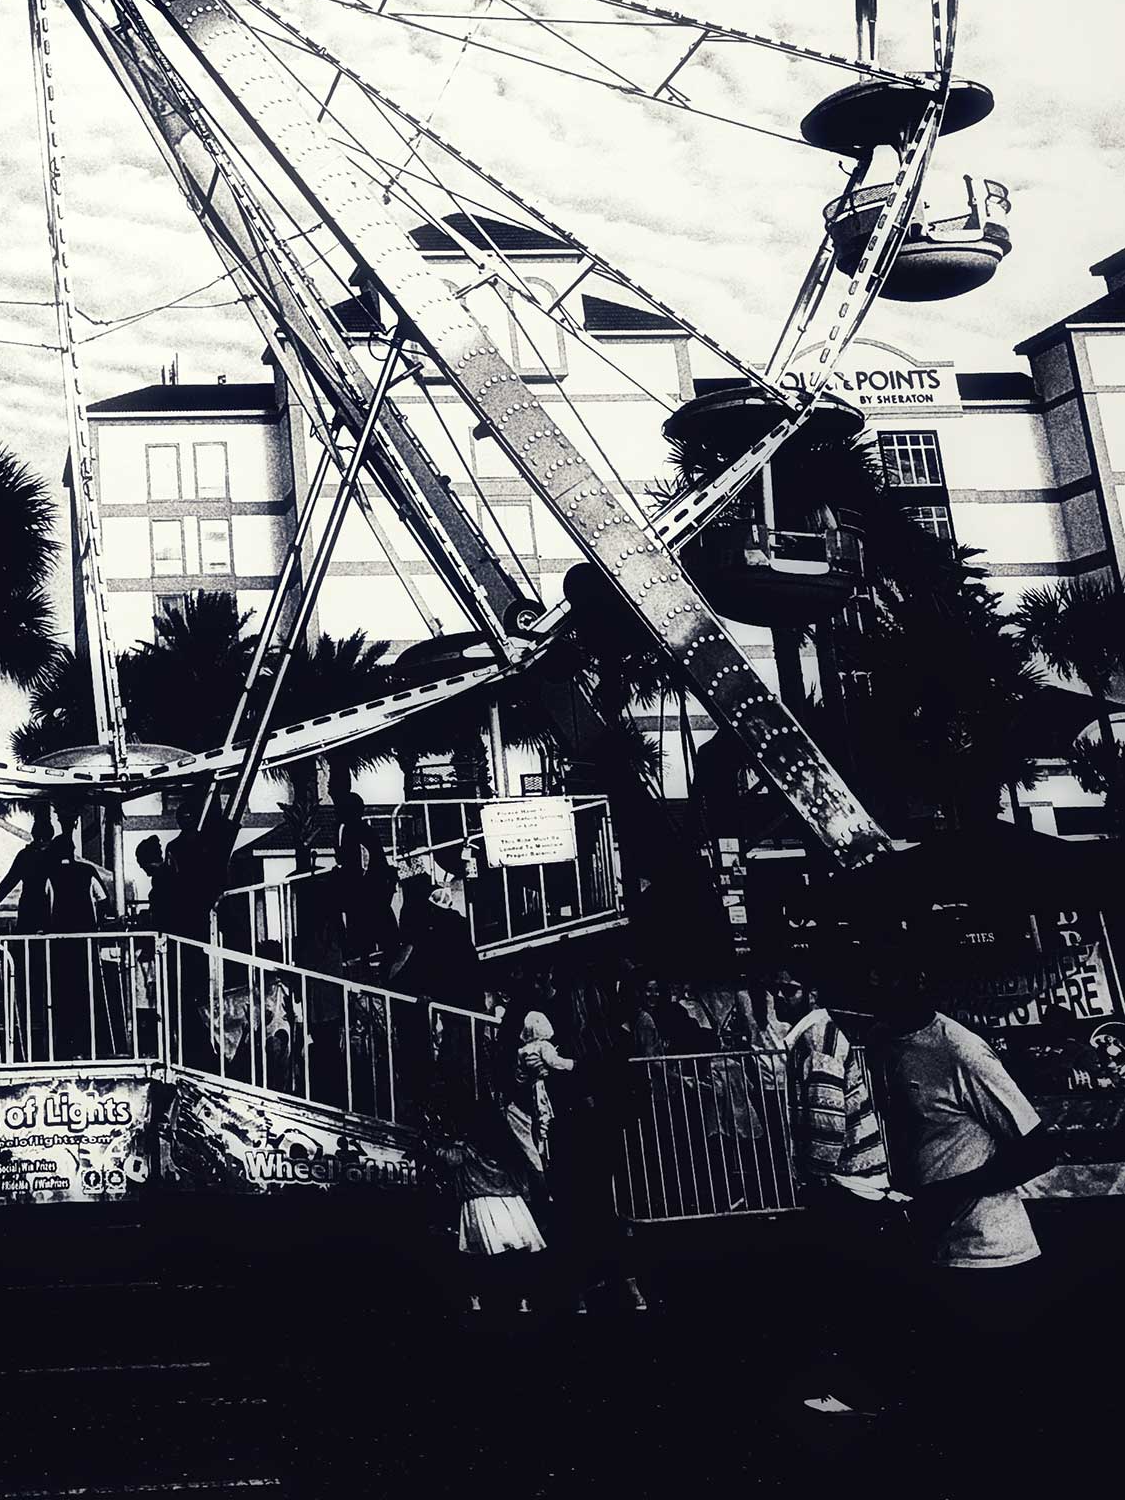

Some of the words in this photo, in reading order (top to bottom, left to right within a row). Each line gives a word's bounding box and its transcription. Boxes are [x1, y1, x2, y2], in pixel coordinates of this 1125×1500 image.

[856, 369, 940, 390] POINTS
[859, 395, 873, 404] BY
[877, 394, 934, 404] SHERATON
[6, 1099, 36, 1127] of
[46, 1092, 132, 1130] Lights
[35, 1160, 56, 1172] Prizes
[246, 1151, 334, 1181] Wheel
